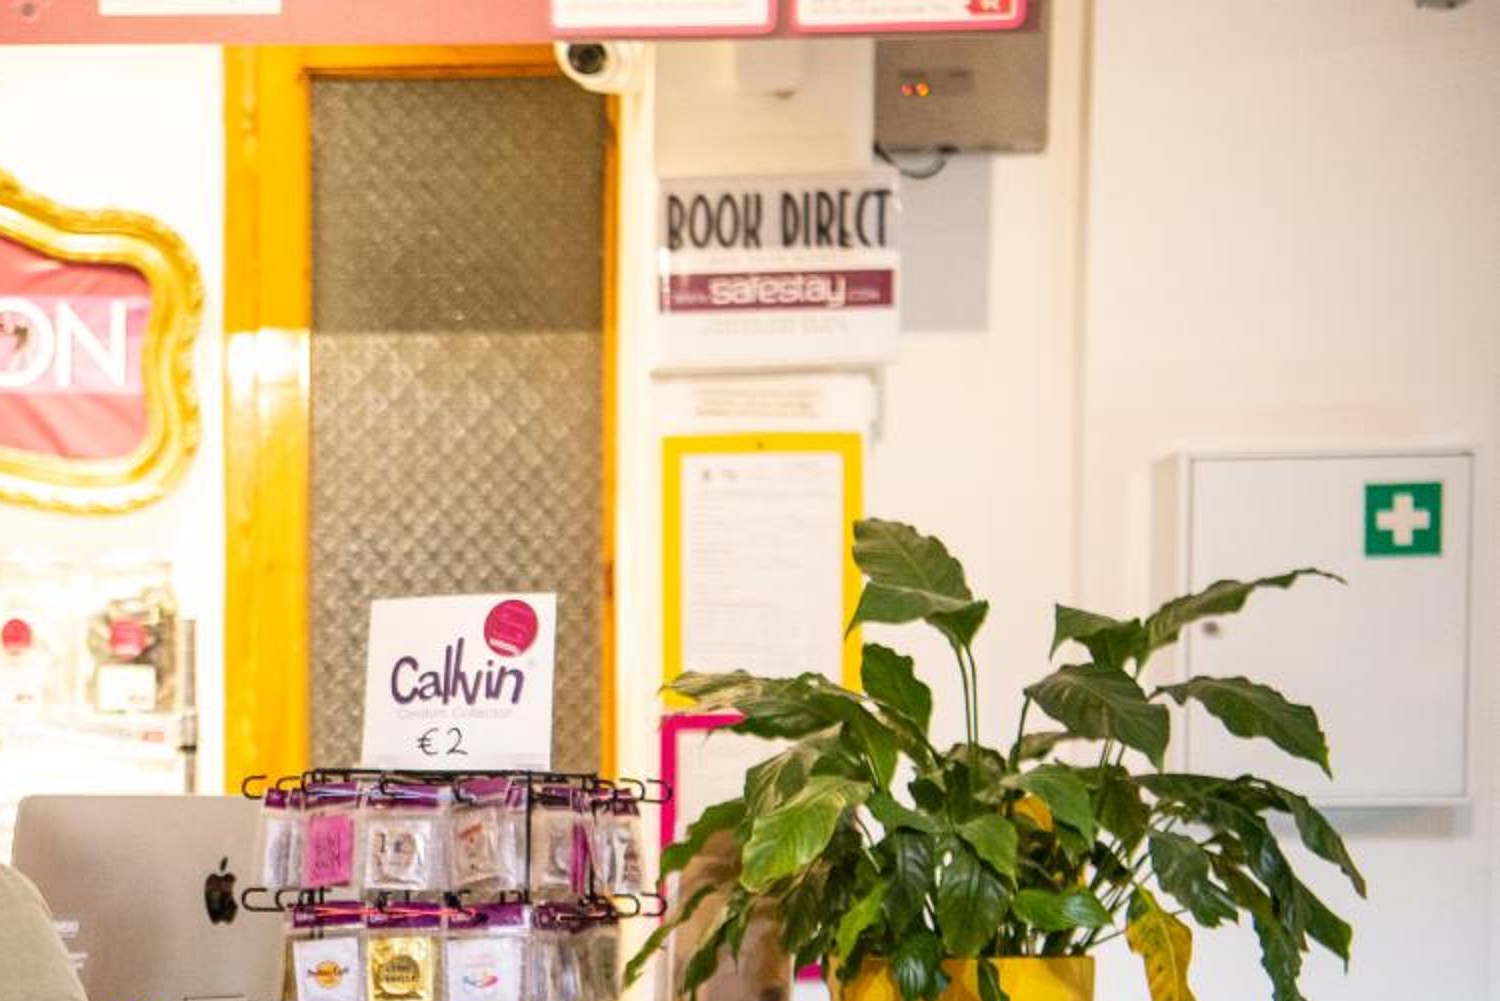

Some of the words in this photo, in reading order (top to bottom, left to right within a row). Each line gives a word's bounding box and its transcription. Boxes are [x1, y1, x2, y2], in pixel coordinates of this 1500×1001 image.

[666, 193, 763, 250] BOOK
[780, 188, 894, 248] DIRECT
[707, 273, 847, 308] safestay
